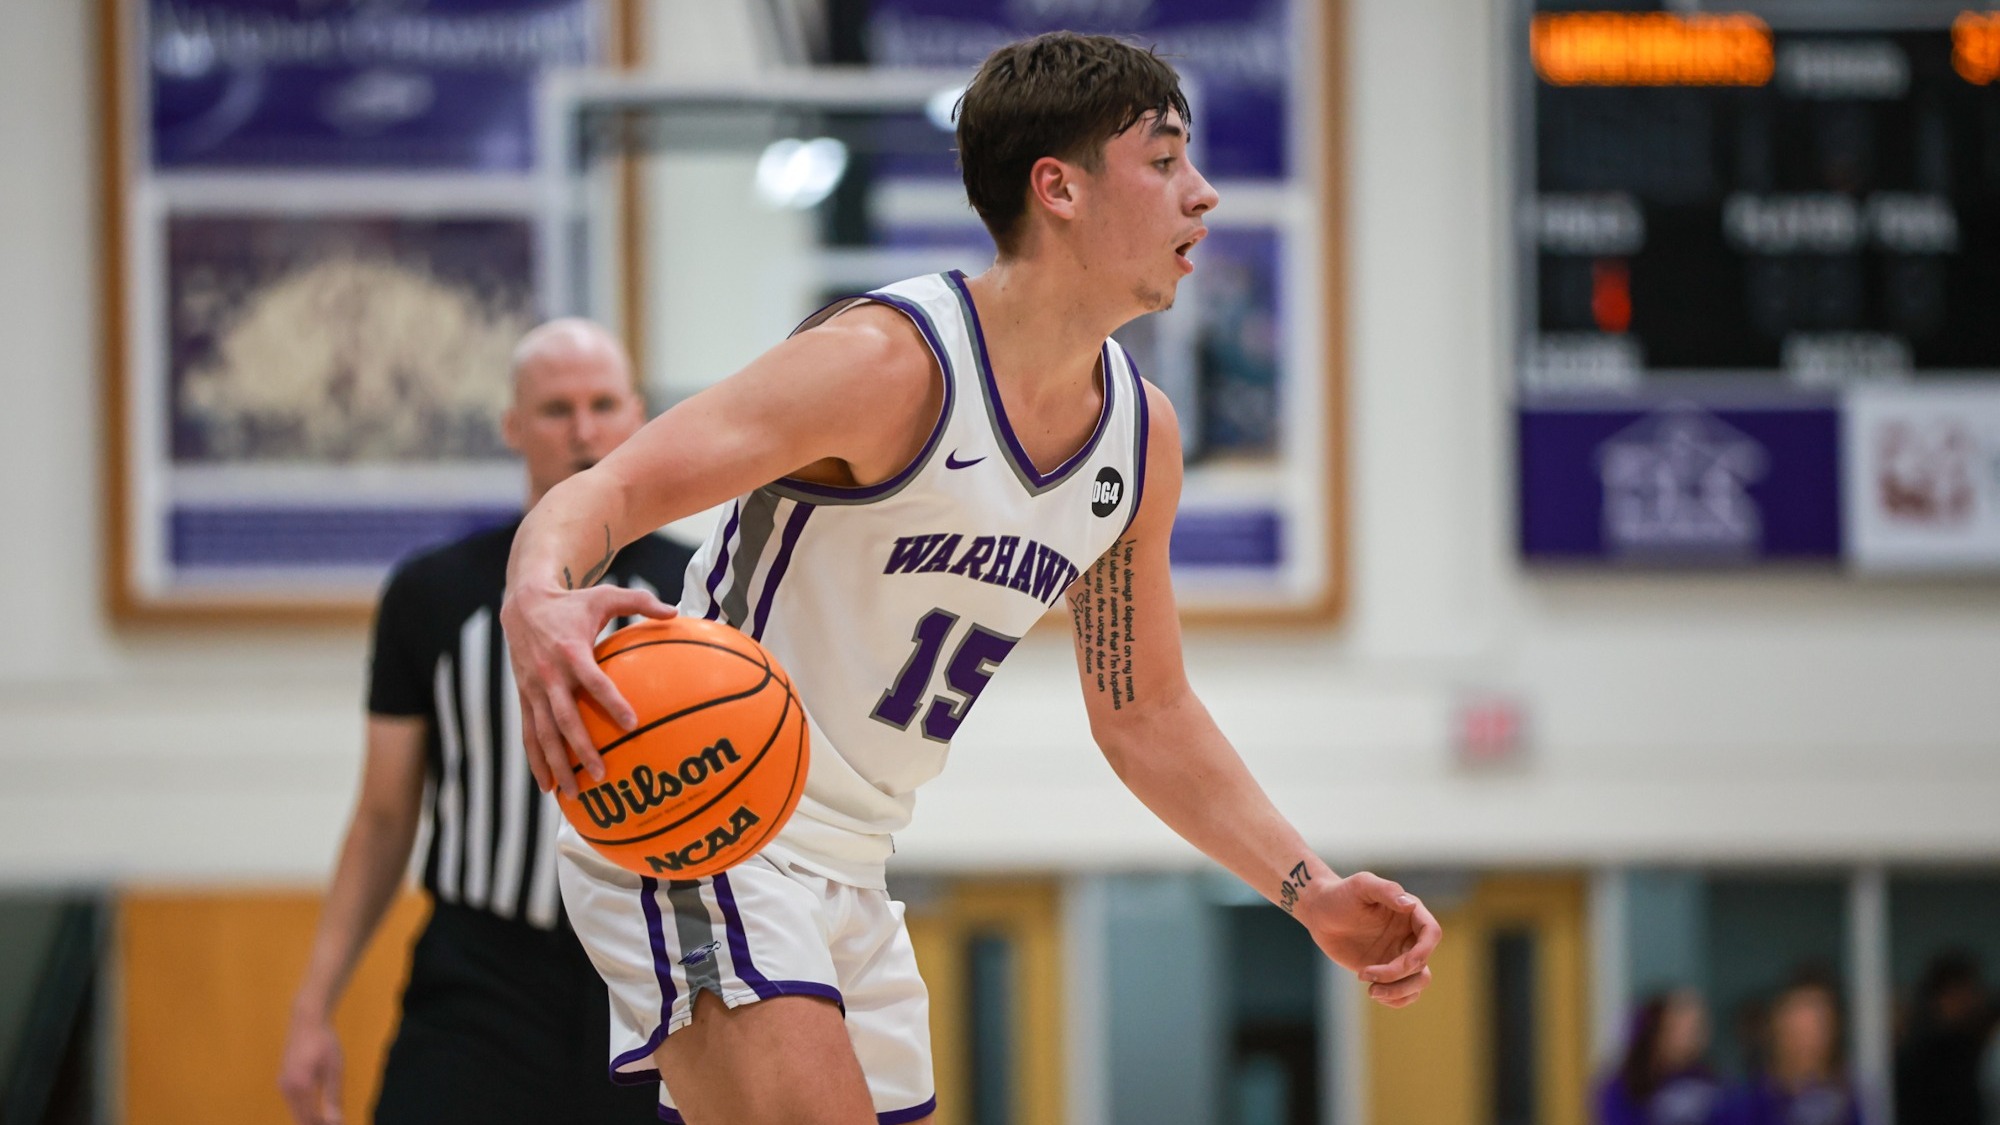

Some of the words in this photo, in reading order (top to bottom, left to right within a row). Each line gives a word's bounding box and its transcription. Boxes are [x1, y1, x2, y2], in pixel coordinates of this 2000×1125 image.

[1092, 480, 1120, 504] DG4
[1124, 546, 1133, 566] can
[1110, 560, 1119, 585] when
[1085, 589, 1091, 603] me
[1094, 577, 1104, 594] say
[1122, 568, 1135, 602] always
[1097, 597, 1106, 612] the
[1085, 606, 1094, 631] back
[1122, 605, 1136, 642] depend
[1085, 634, 1092, 643] in
[1096, 615, 1106, 647] words
[1110, 631, 1120, 651] that
[1085, 647, 1094, 674] focus
[1096, 650, 1106, 670] that
[1111, 654, 1121, 669] I'm
[1124, 645, 1132, 658] on
[868, 607, 1022, 744] 15
[1122, 660, 1132, 674] my
[1097, 673, 1105, 692] can
[1125, 676, 1135, 702] mama
[577, 737, 742, 830] Wilson
[644, 805, 761, 874] NCAA
